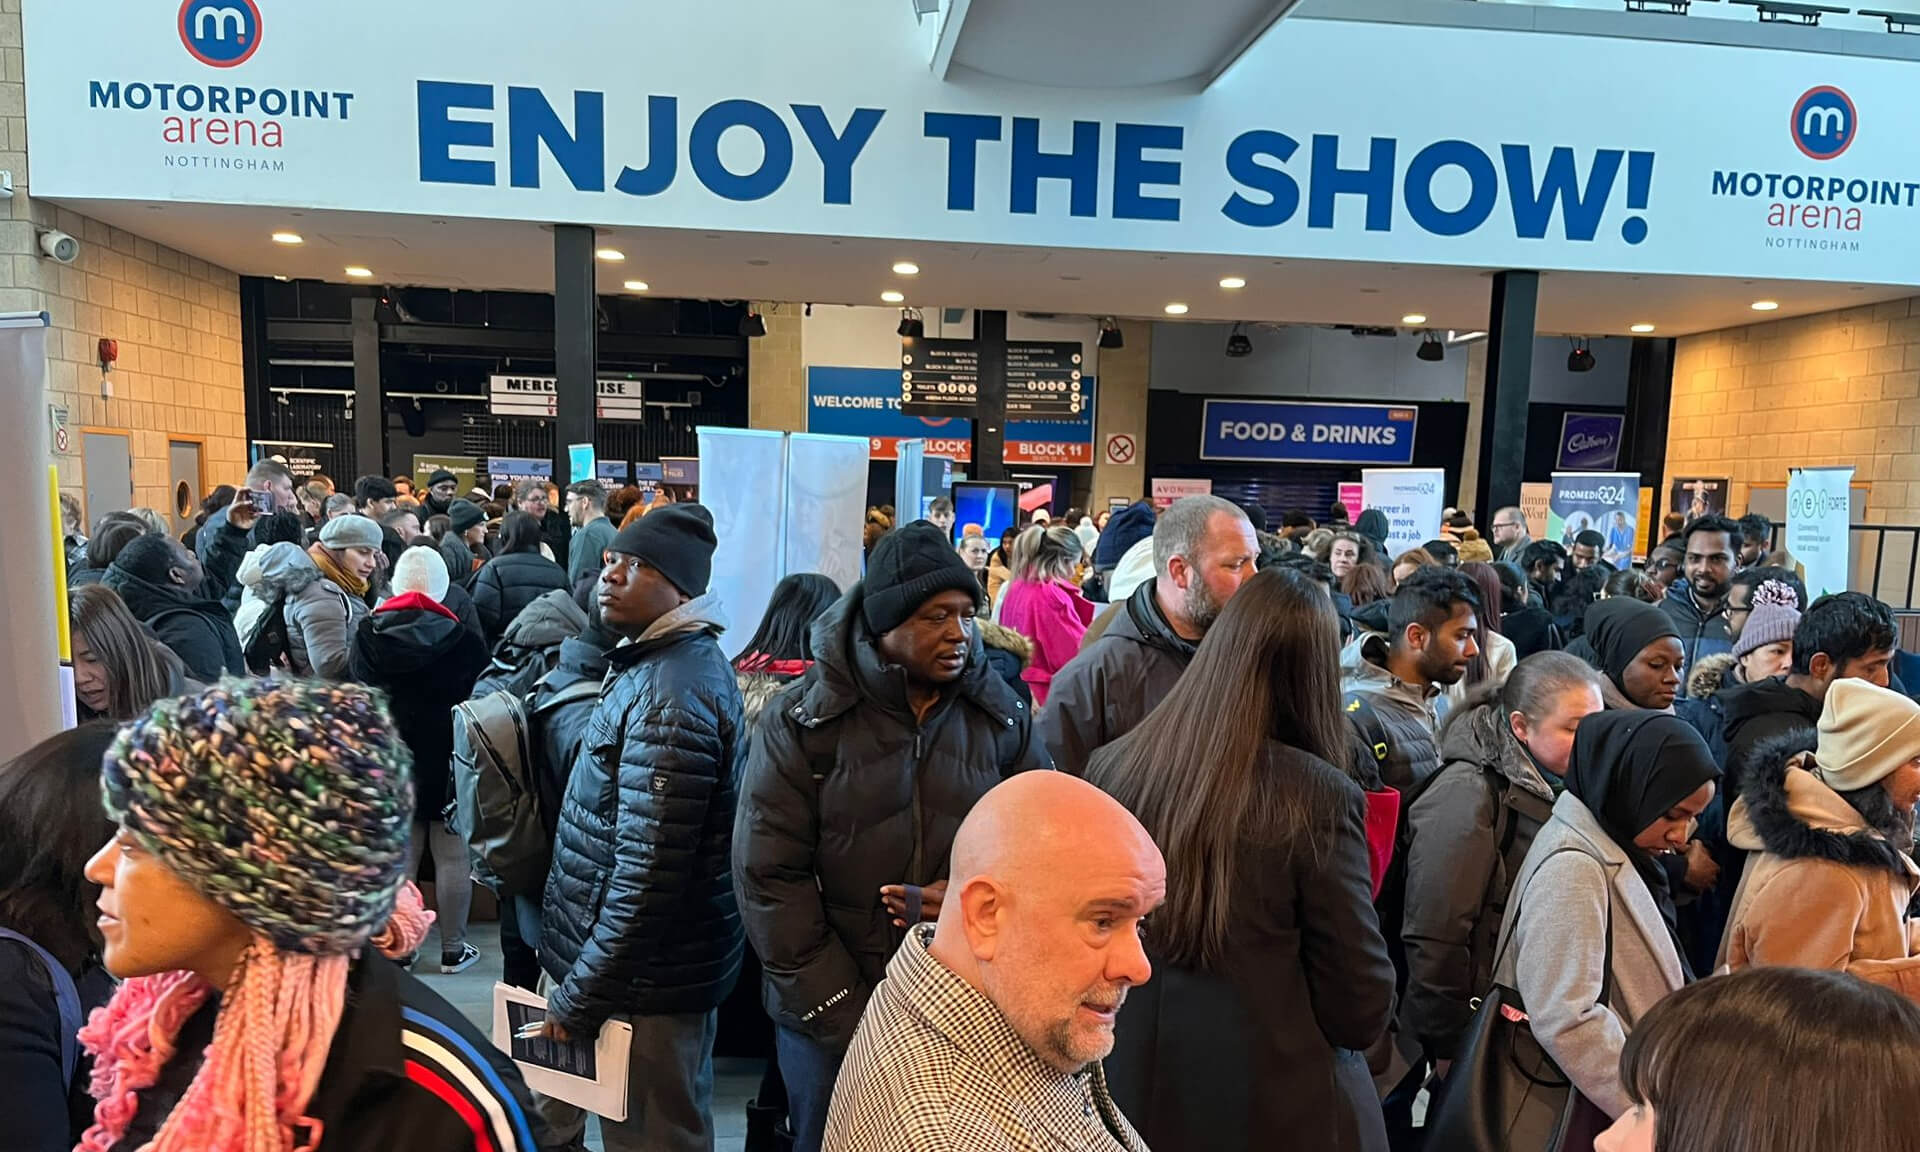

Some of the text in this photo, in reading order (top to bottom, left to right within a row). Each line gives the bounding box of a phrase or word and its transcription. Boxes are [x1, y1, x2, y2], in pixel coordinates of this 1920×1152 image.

[89, 80, 355, 120] MOTORPOINT
[163, 116, 284, 148] arena
[164, 155, 285, 172] NOTTINGHAM
[417, 80, 1655, 246] ENJOY THE SHOW!
[1711, 170, 1920, 207] MOTORPOINT
[1767, 202, 1862, 232] arena
[1765, 236, 1860, 252] NOTTINGHAM
[813, 394, 884, 409] WELCOME
[1219, 421, 1397, 446] FOOD & DRINKS
[871, 438, 882, 451] 9
[1019, 442, 1083, 457] BLOCK 11
[491, 473, 508, 481] FIND
[1156, 485, 1185, 494] AVON
[1402, 503, 1410, 514] in
[1392, 519, 1415, 527] more
[1408, 530, 1422, 542] job
